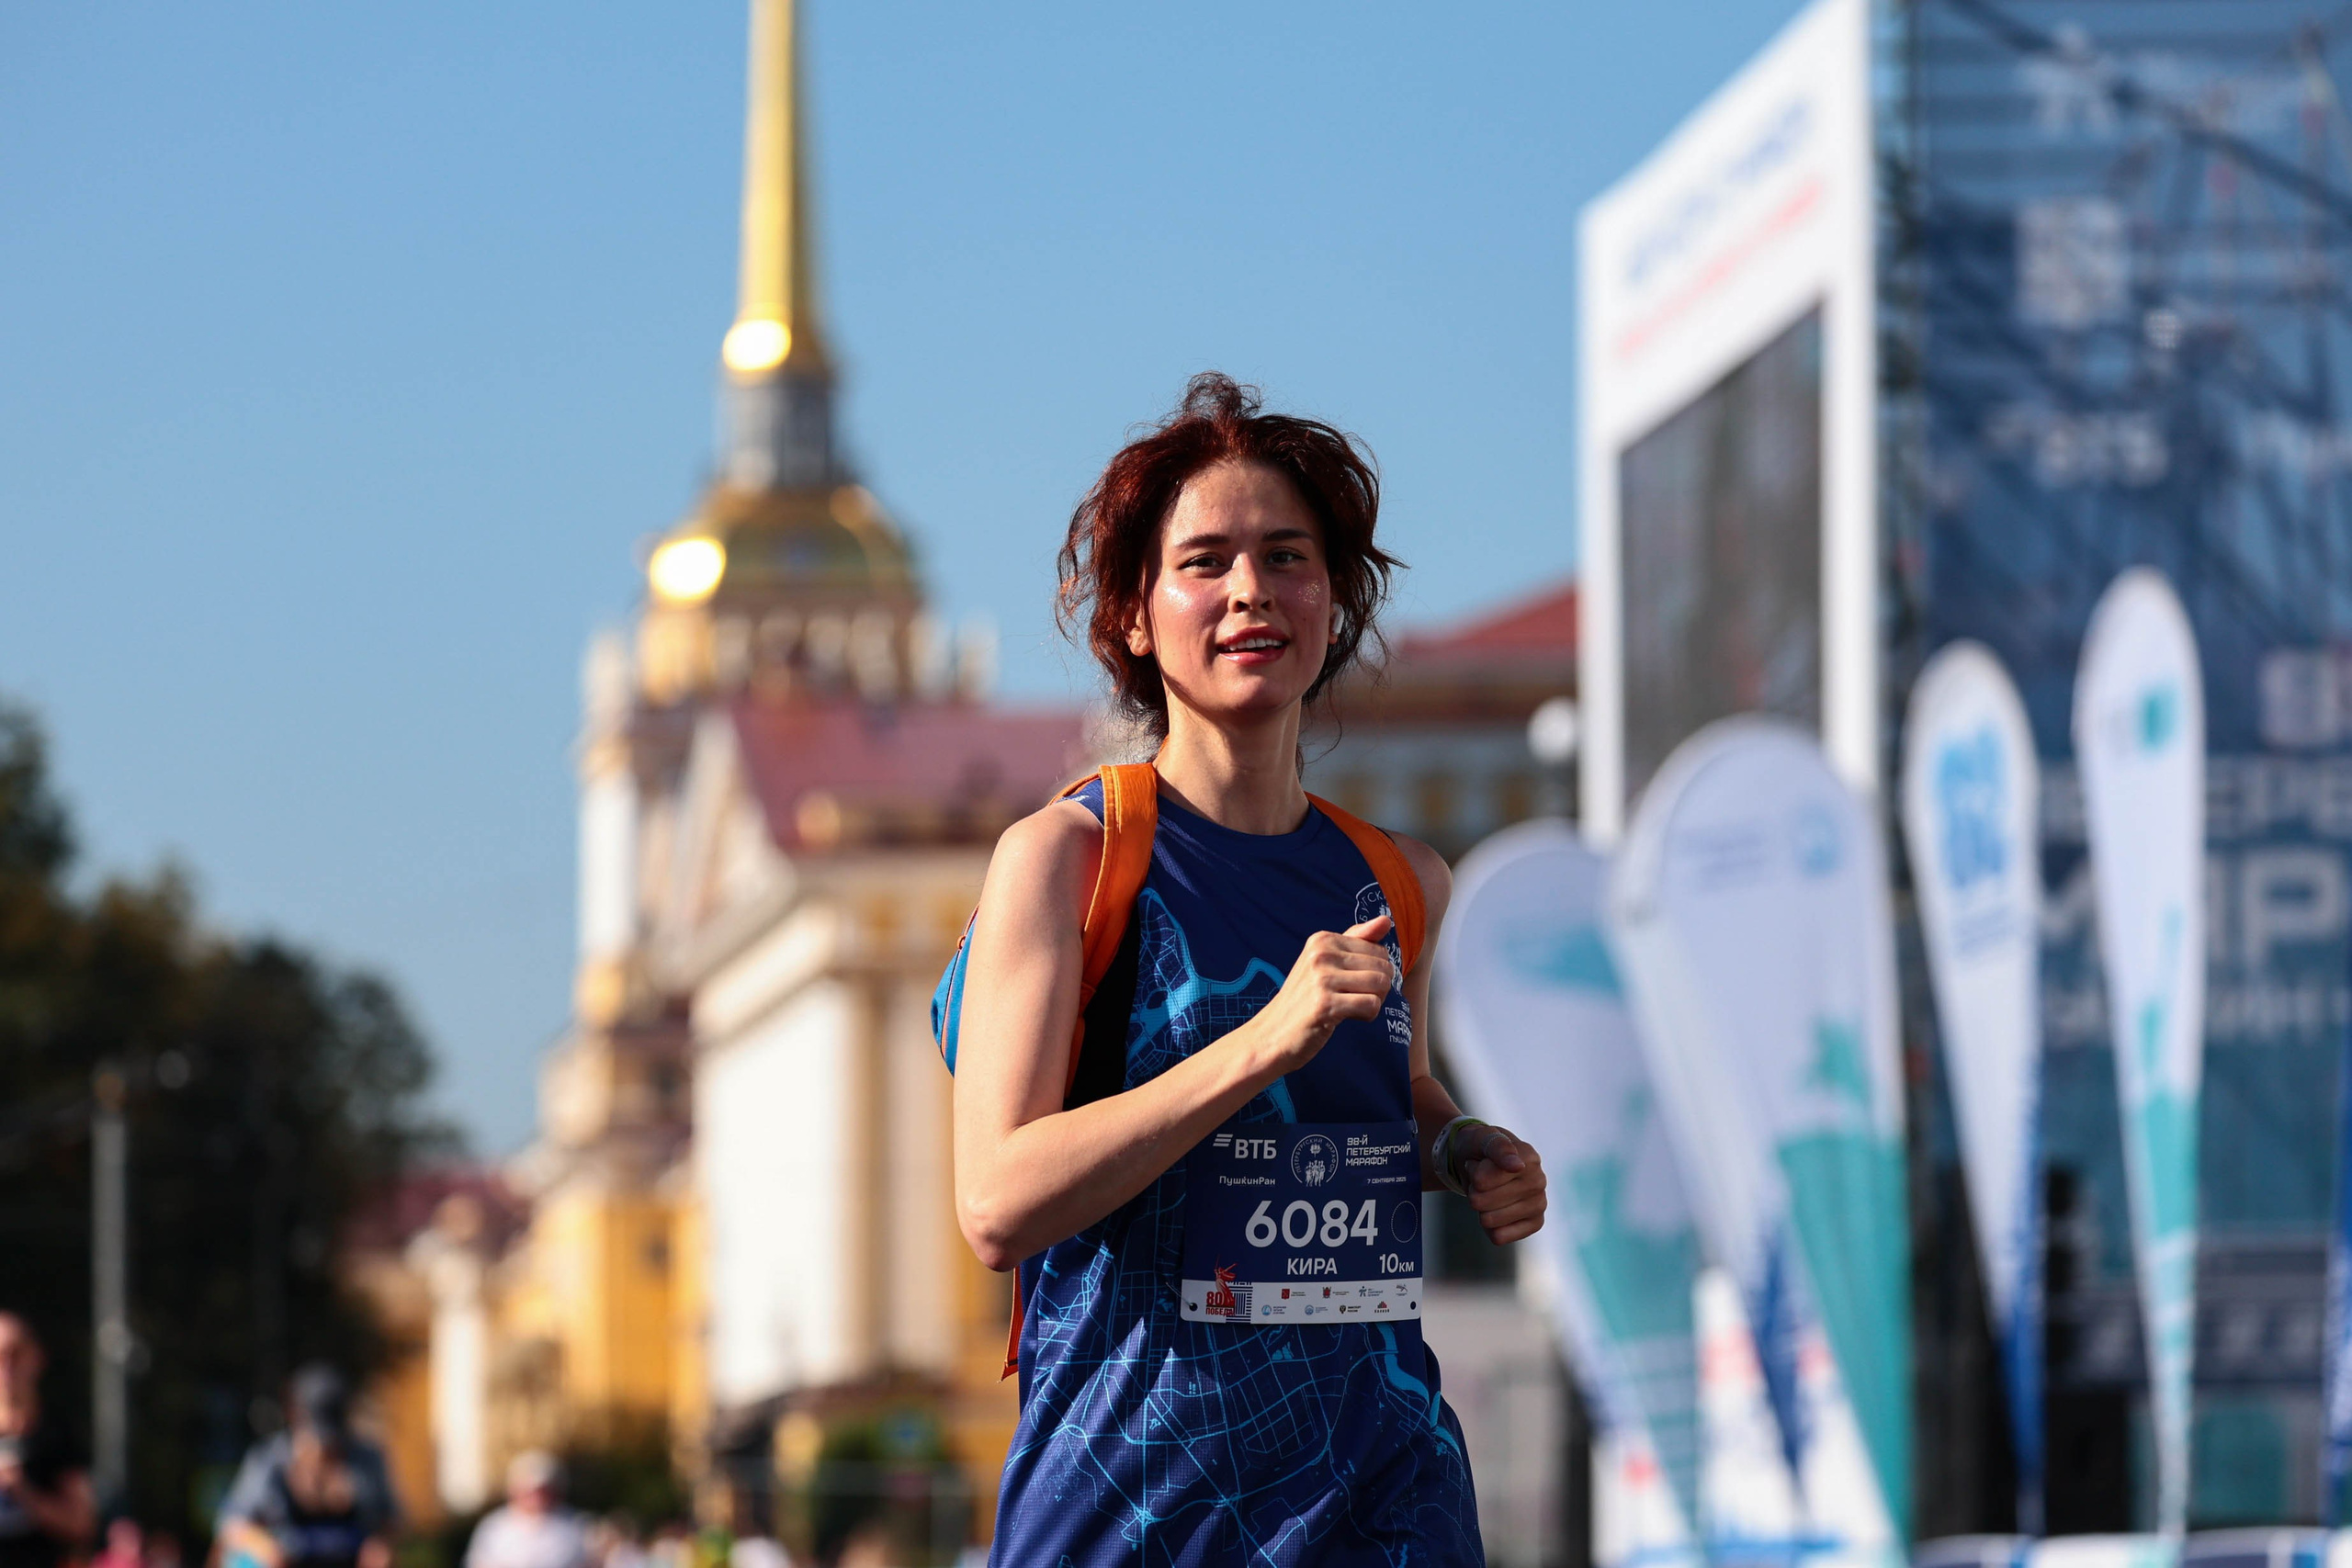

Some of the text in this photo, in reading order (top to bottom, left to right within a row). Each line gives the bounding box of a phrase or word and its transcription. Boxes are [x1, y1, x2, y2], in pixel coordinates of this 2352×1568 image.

[1346, 1134, 1369, 1146] 98-Й
[1235, 1138, 1278, 1160] ВТБ
[1346, 1142, 1411, 1156] ПЕТЕРБУРГСКИЙ
[1345, 1156, 1388, 1167] МАРАФОН
[1245, 1199, 1378, 1247] 6084
[1286, 1258, 1339, 1276] КИРА
